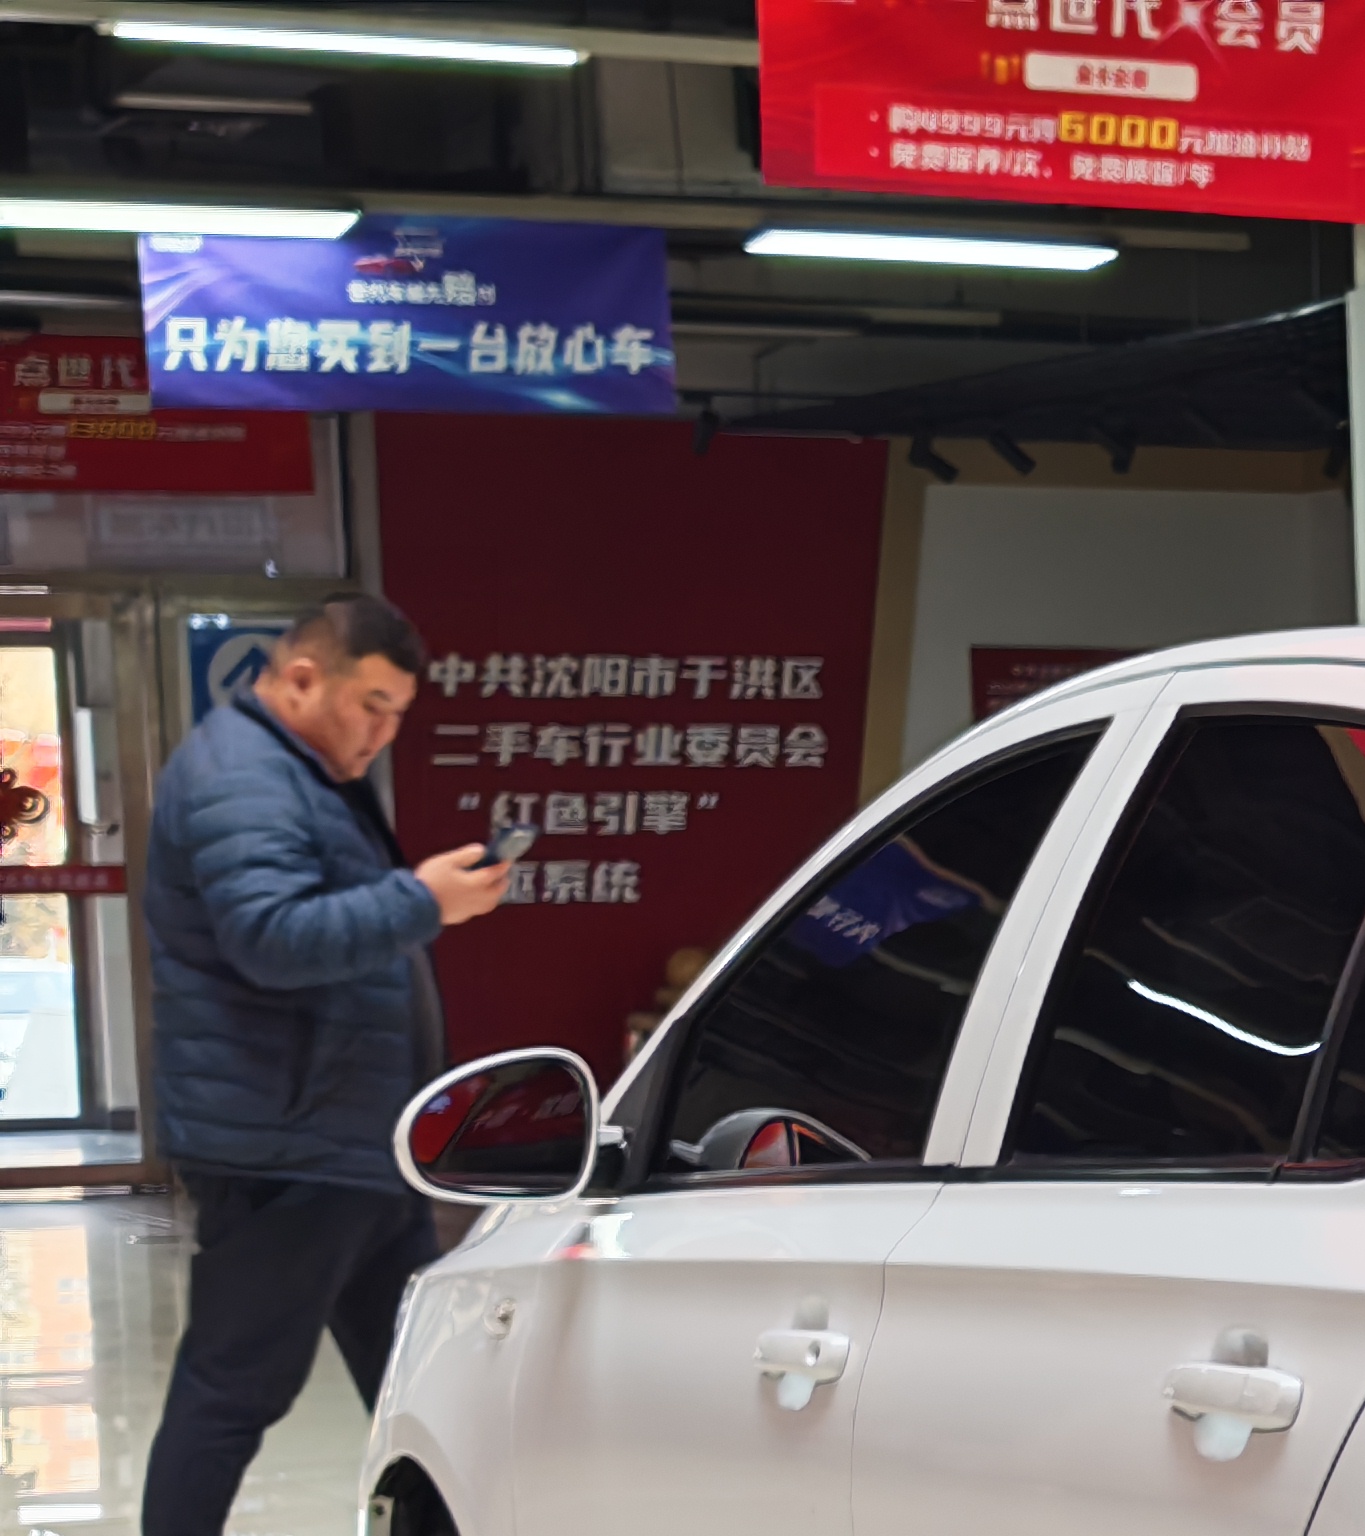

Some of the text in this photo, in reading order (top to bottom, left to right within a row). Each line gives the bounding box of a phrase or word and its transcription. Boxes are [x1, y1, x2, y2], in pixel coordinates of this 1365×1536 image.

[162, 315, 655, 376] 只为您买到一台放心车
[427, 653, 825, 699] 中共沈阳市于洪区
[431, 722, 828, 768] 二手车行业委员会
